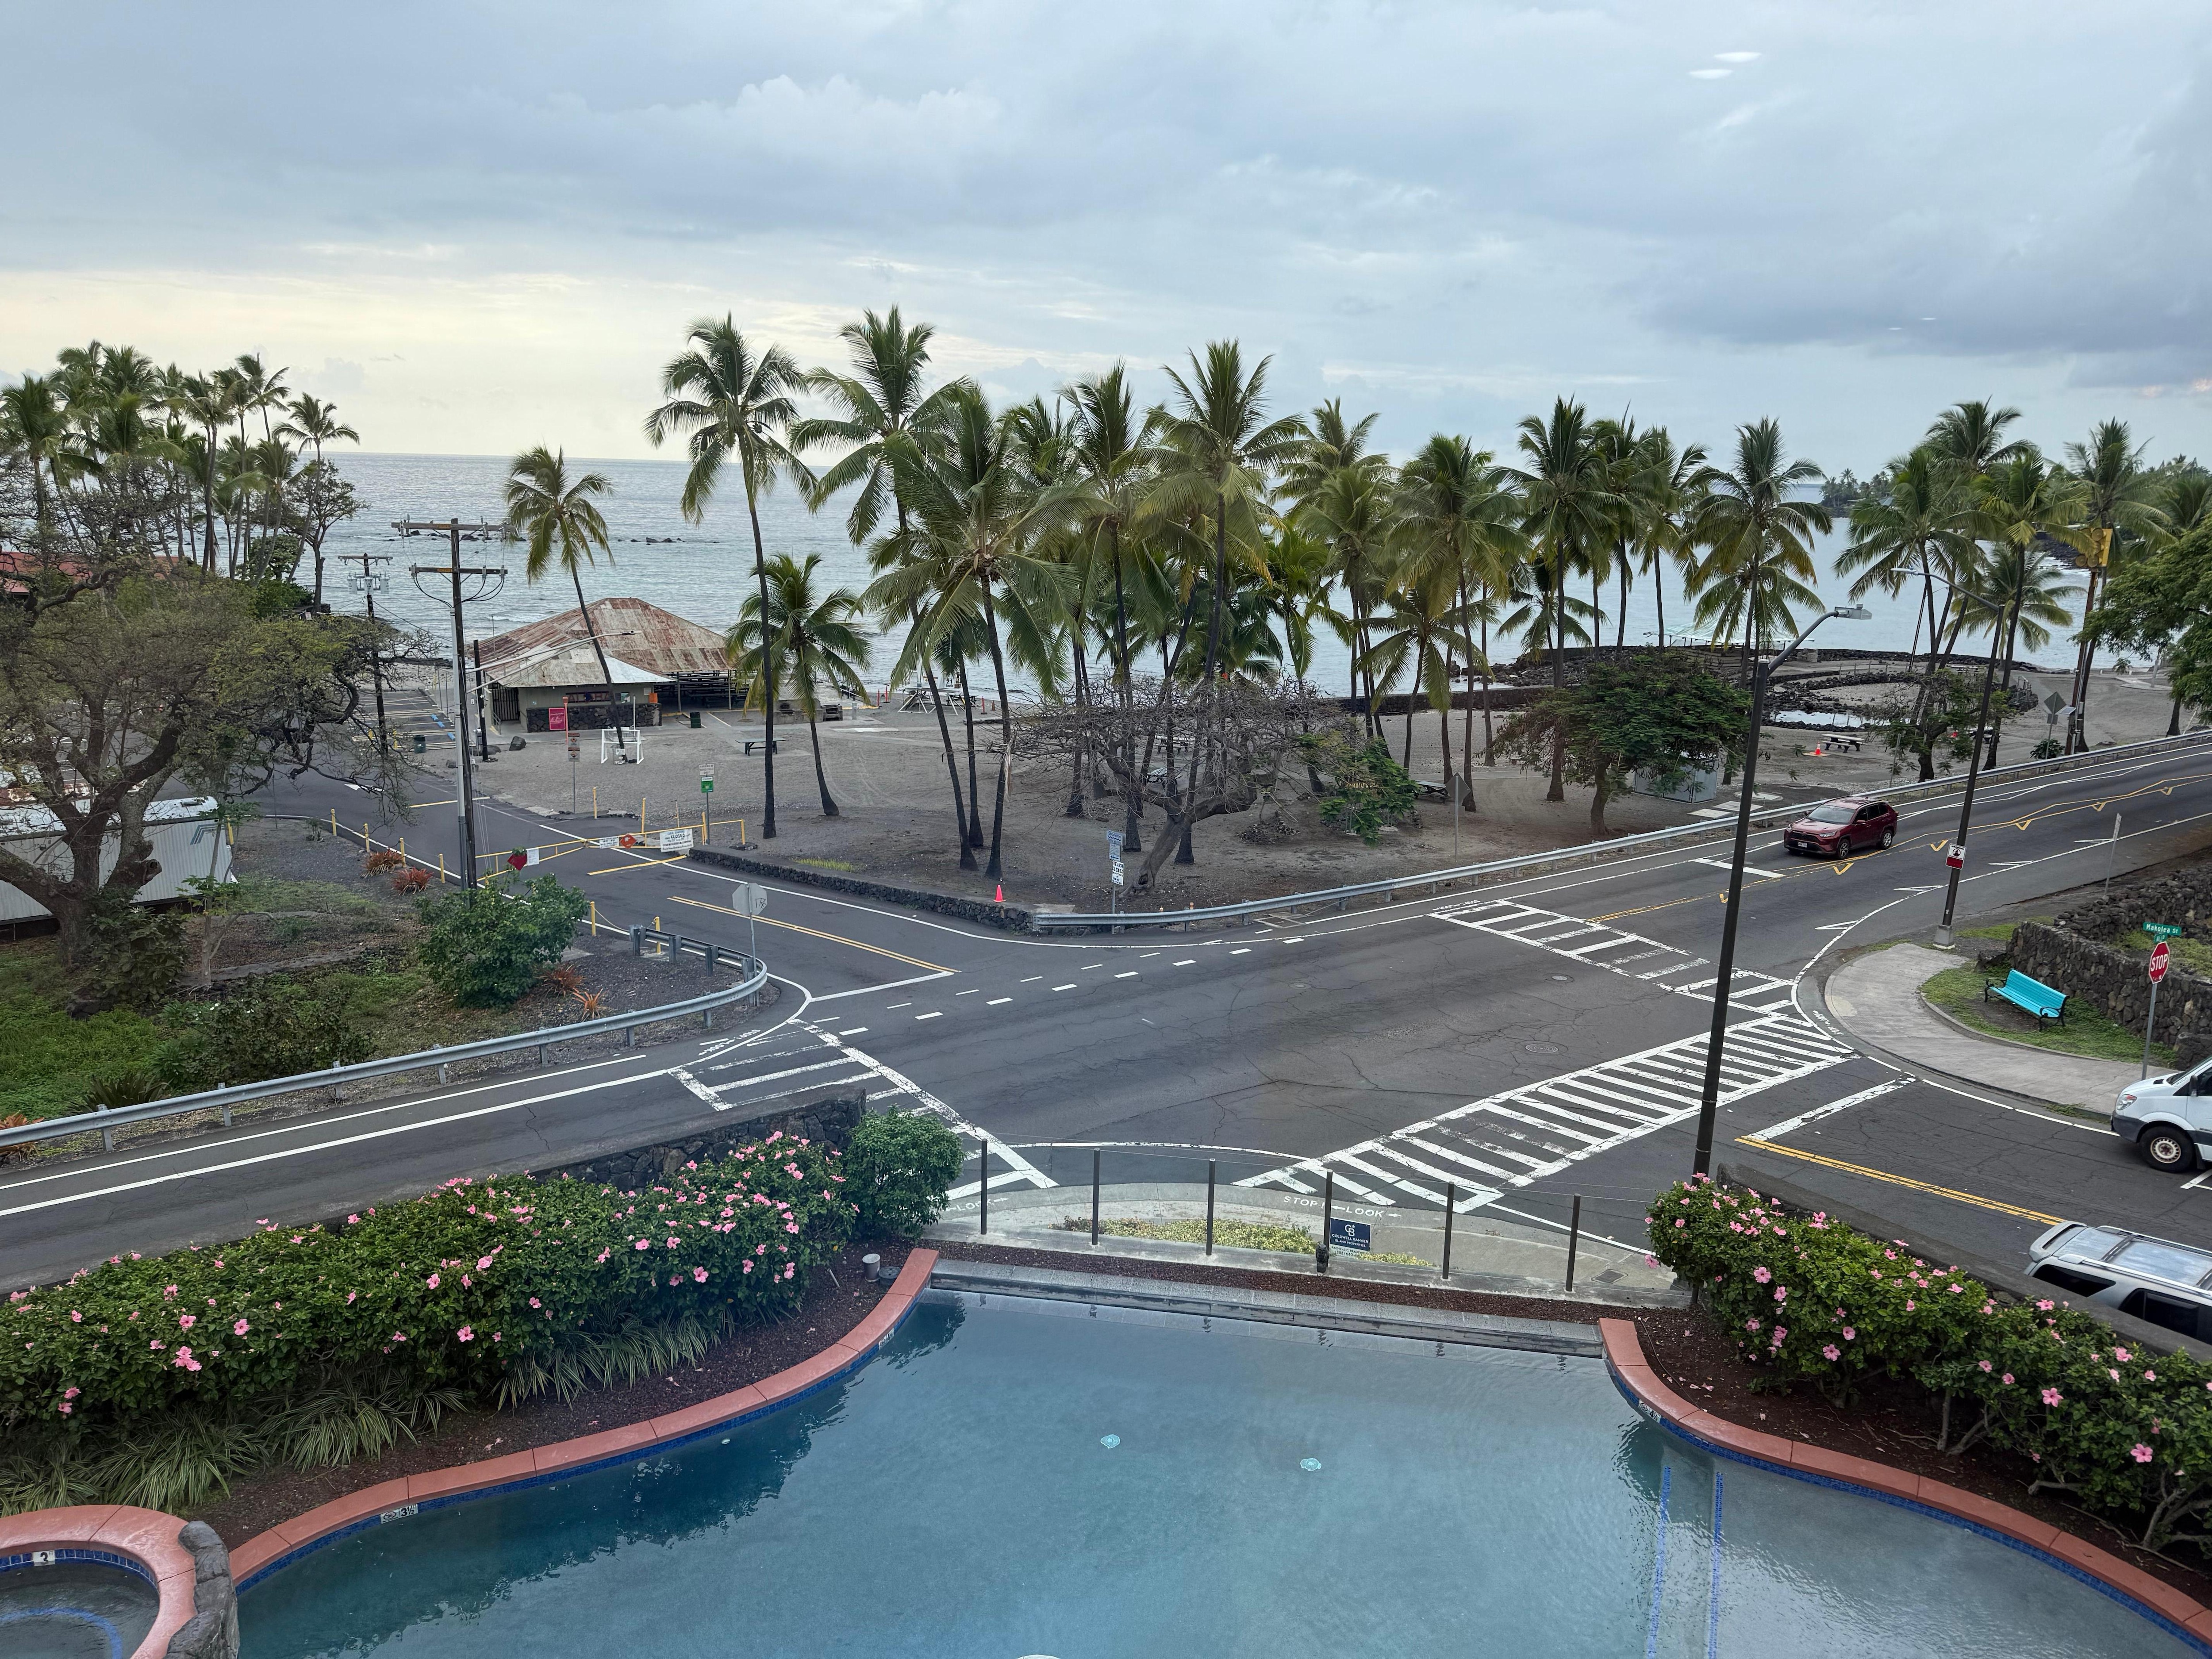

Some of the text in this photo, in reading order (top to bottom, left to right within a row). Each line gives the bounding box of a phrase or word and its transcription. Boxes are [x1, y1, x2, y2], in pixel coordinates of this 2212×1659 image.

[2146, 923, 2170, 933] Makolea
[2151, 953, 2168, 972] STOP
[1346, 1206, 1384, 1218] LOOK
